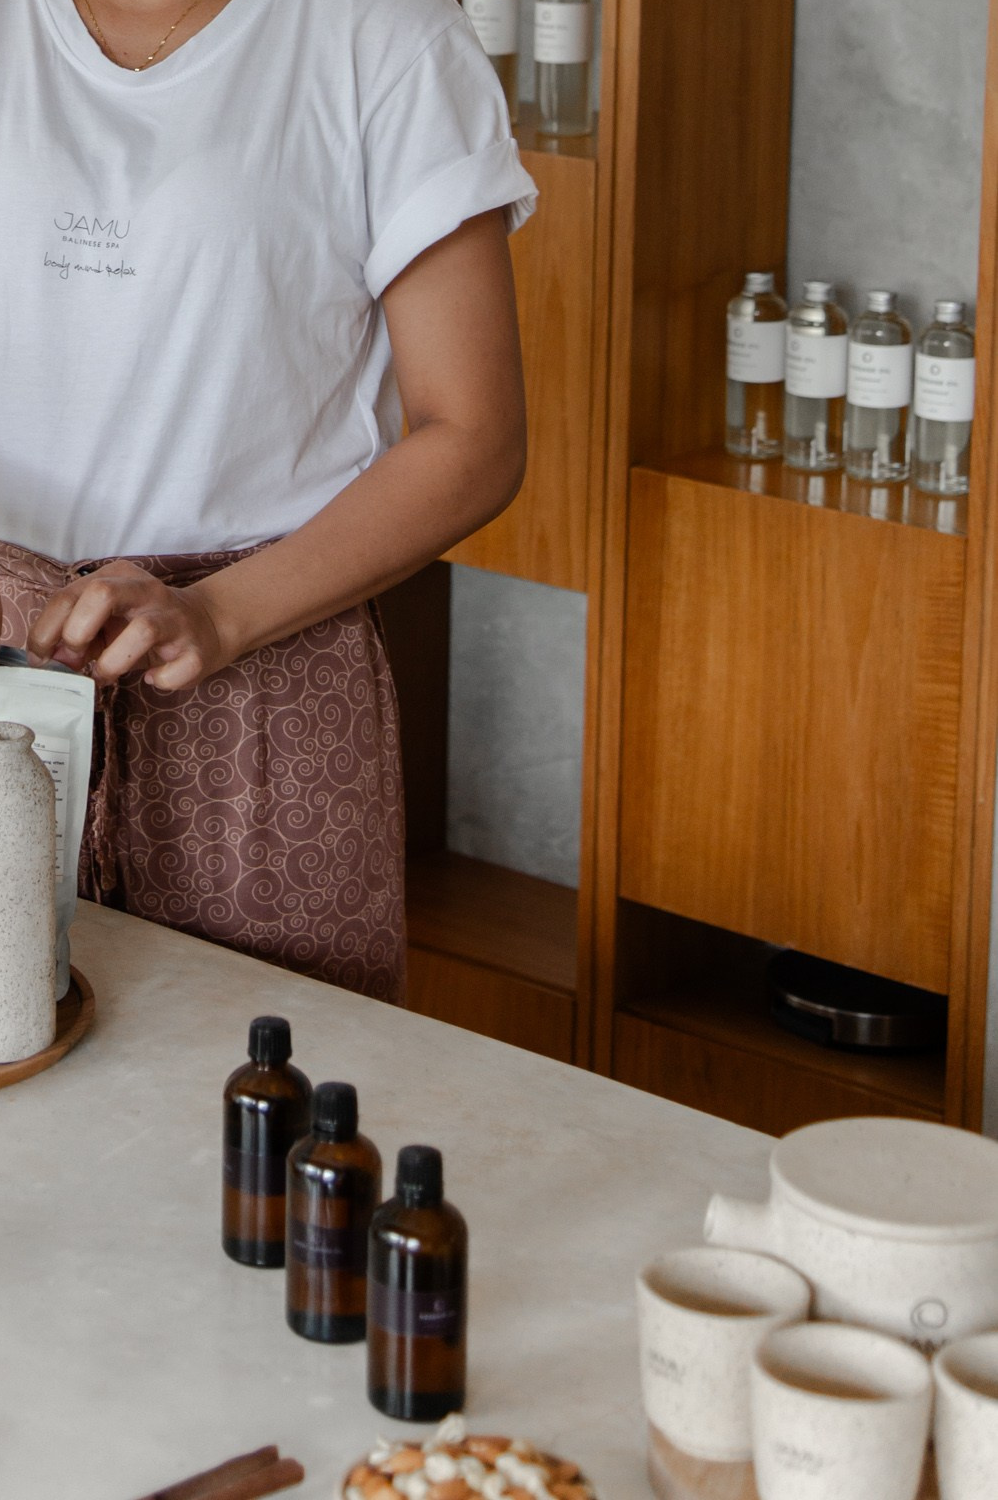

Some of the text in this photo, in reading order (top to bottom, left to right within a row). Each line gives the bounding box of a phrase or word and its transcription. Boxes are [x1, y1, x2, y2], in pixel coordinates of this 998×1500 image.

[53, 211, 131, 239] JAMU
[62, 235, 102, 248] BALINESE
[43, 251, 71, 280] body
[74, 260, 104, 274] mind
